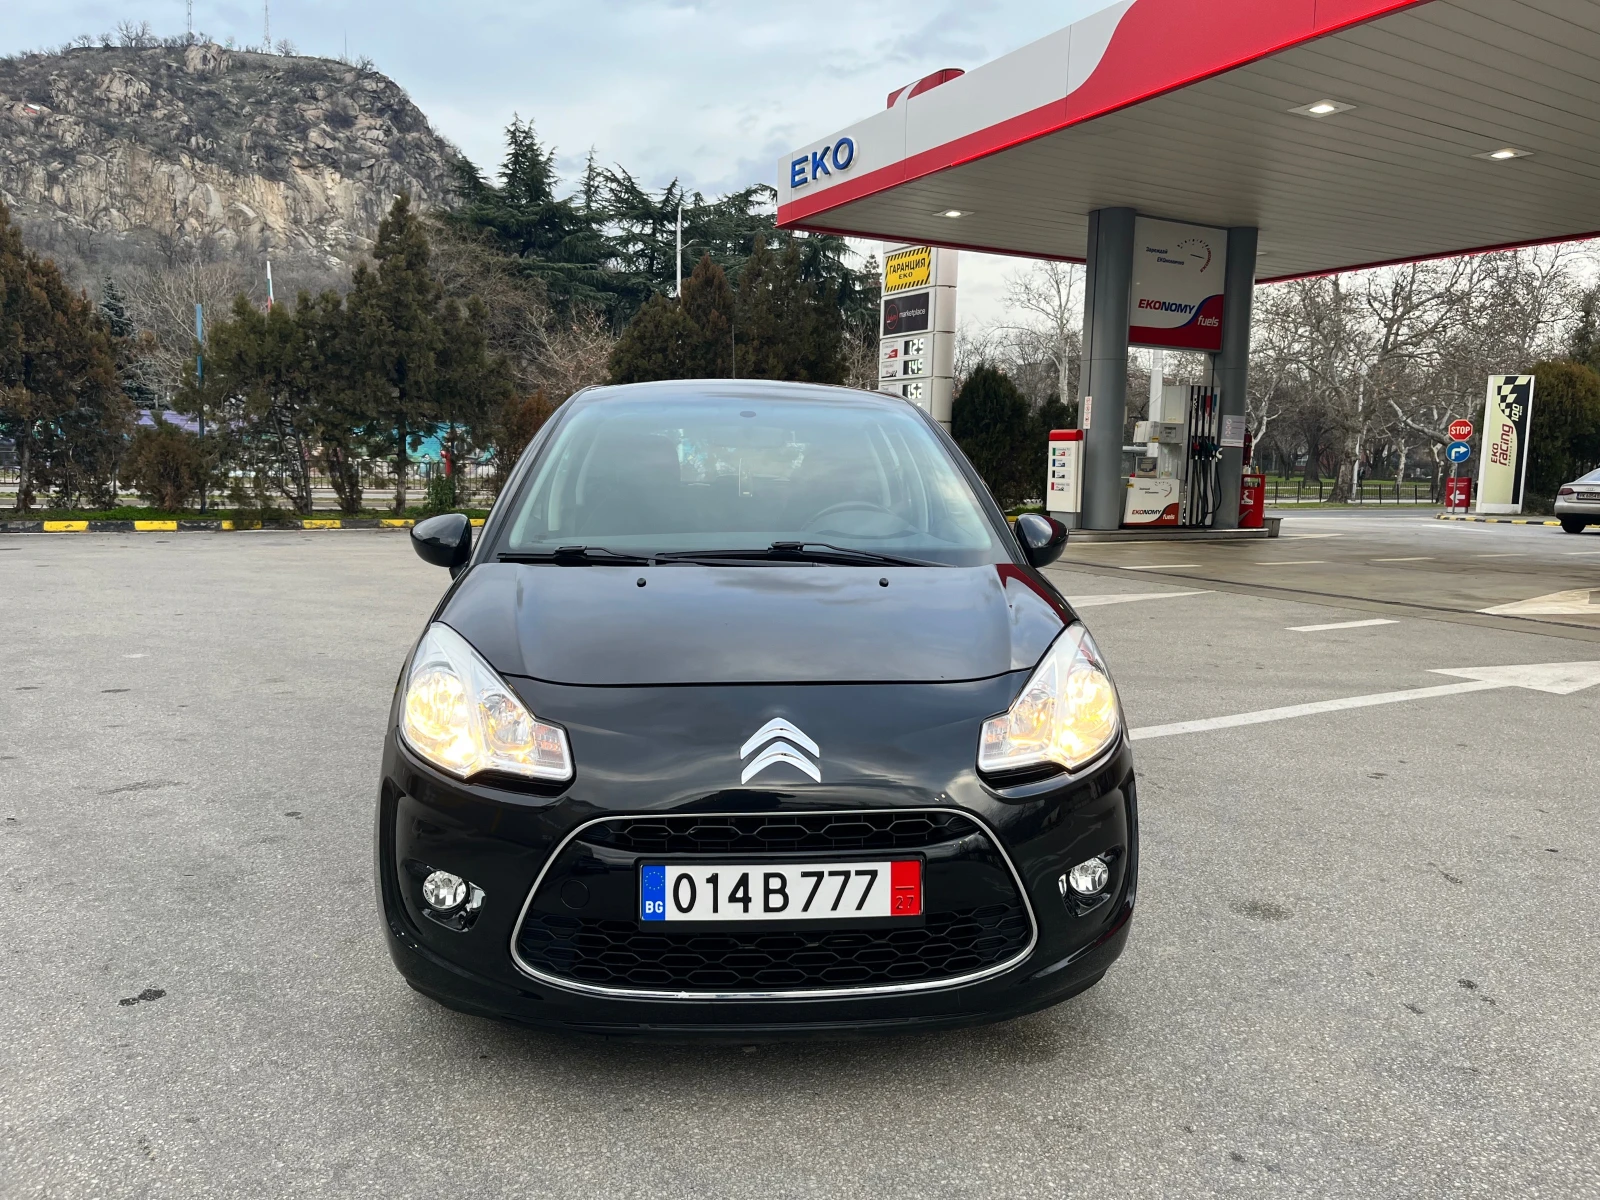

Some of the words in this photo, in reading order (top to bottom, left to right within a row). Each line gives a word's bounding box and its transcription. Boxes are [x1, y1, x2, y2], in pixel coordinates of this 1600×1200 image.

[791, 137, 856, 188] EKO
[889, 257, 926, 275] ГАРАНЦИЯ
[898, 271, 913, 280] EKO
[899, 308, 926, 318] marketplace
[1138, 298, 1196, 314] EKONOMY
[1197, 315, 1219, 327] fuels
[1511, 403, 1520, 421] 100
[1450, 426, 1471, 435] STOP
[1499, 423, 1514, 466] racing
[1491, 442, 1499, 463] EKO
[645, 901, 664, 914] BG
[895, 895, 915, 909] 27
